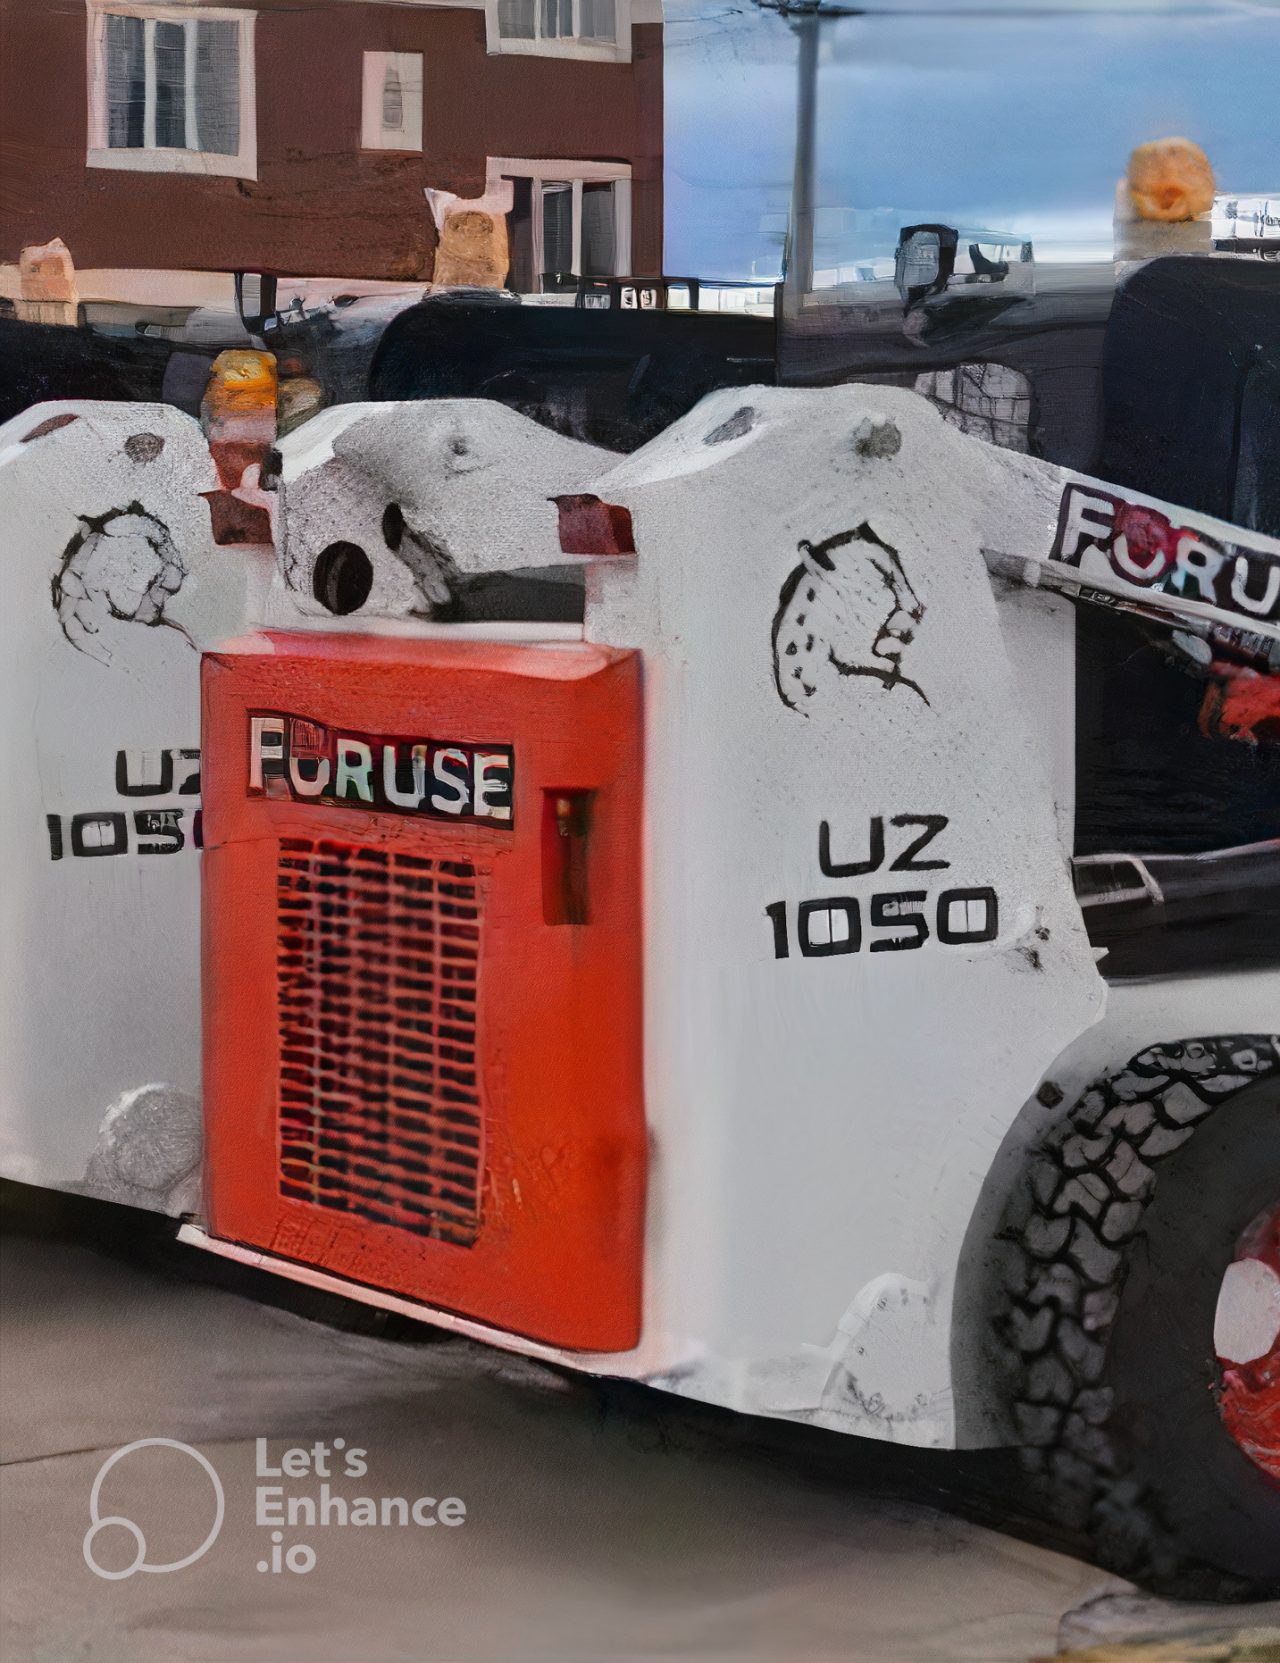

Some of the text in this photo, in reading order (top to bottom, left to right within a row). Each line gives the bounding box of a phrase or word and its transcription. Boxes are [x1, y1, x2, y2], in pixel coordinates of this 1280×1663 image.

[249, 717, 511, 820] FORUSE
[47, 808, 204, 861] 105
[819, 814, 951, 878] UZ
[765, 887, 999, 959] 1050
